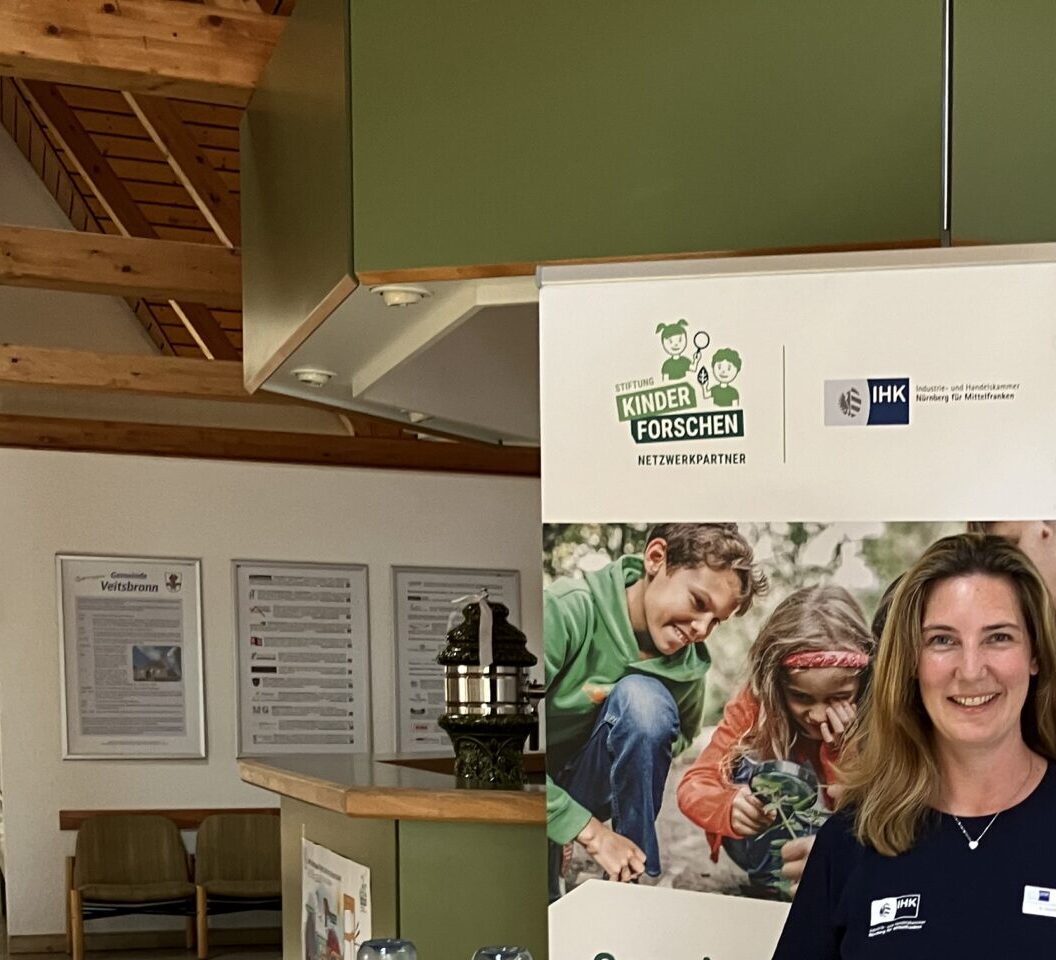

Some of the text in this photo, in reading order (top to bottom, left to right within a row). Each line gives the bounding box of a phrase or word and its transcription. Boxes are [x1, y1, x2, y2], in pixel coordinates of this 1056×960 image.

[615, 377, 654, 392] STIFTUNG
[966, 383, 1020, 391] Handelskammer
[622, 386, 691, 417] KINDER
[872, 385, 907, 405] IHK
[916, 392, 1015, 403] Nürnberg für Mittelfranken
[637, 413, 738, 440] FORSCHEN
[638, 453, 746, 466] NETZWERKPARTNER
[101, 581, 159, 593] Veitsbronn
[896, 898, 918, 909] IHK
